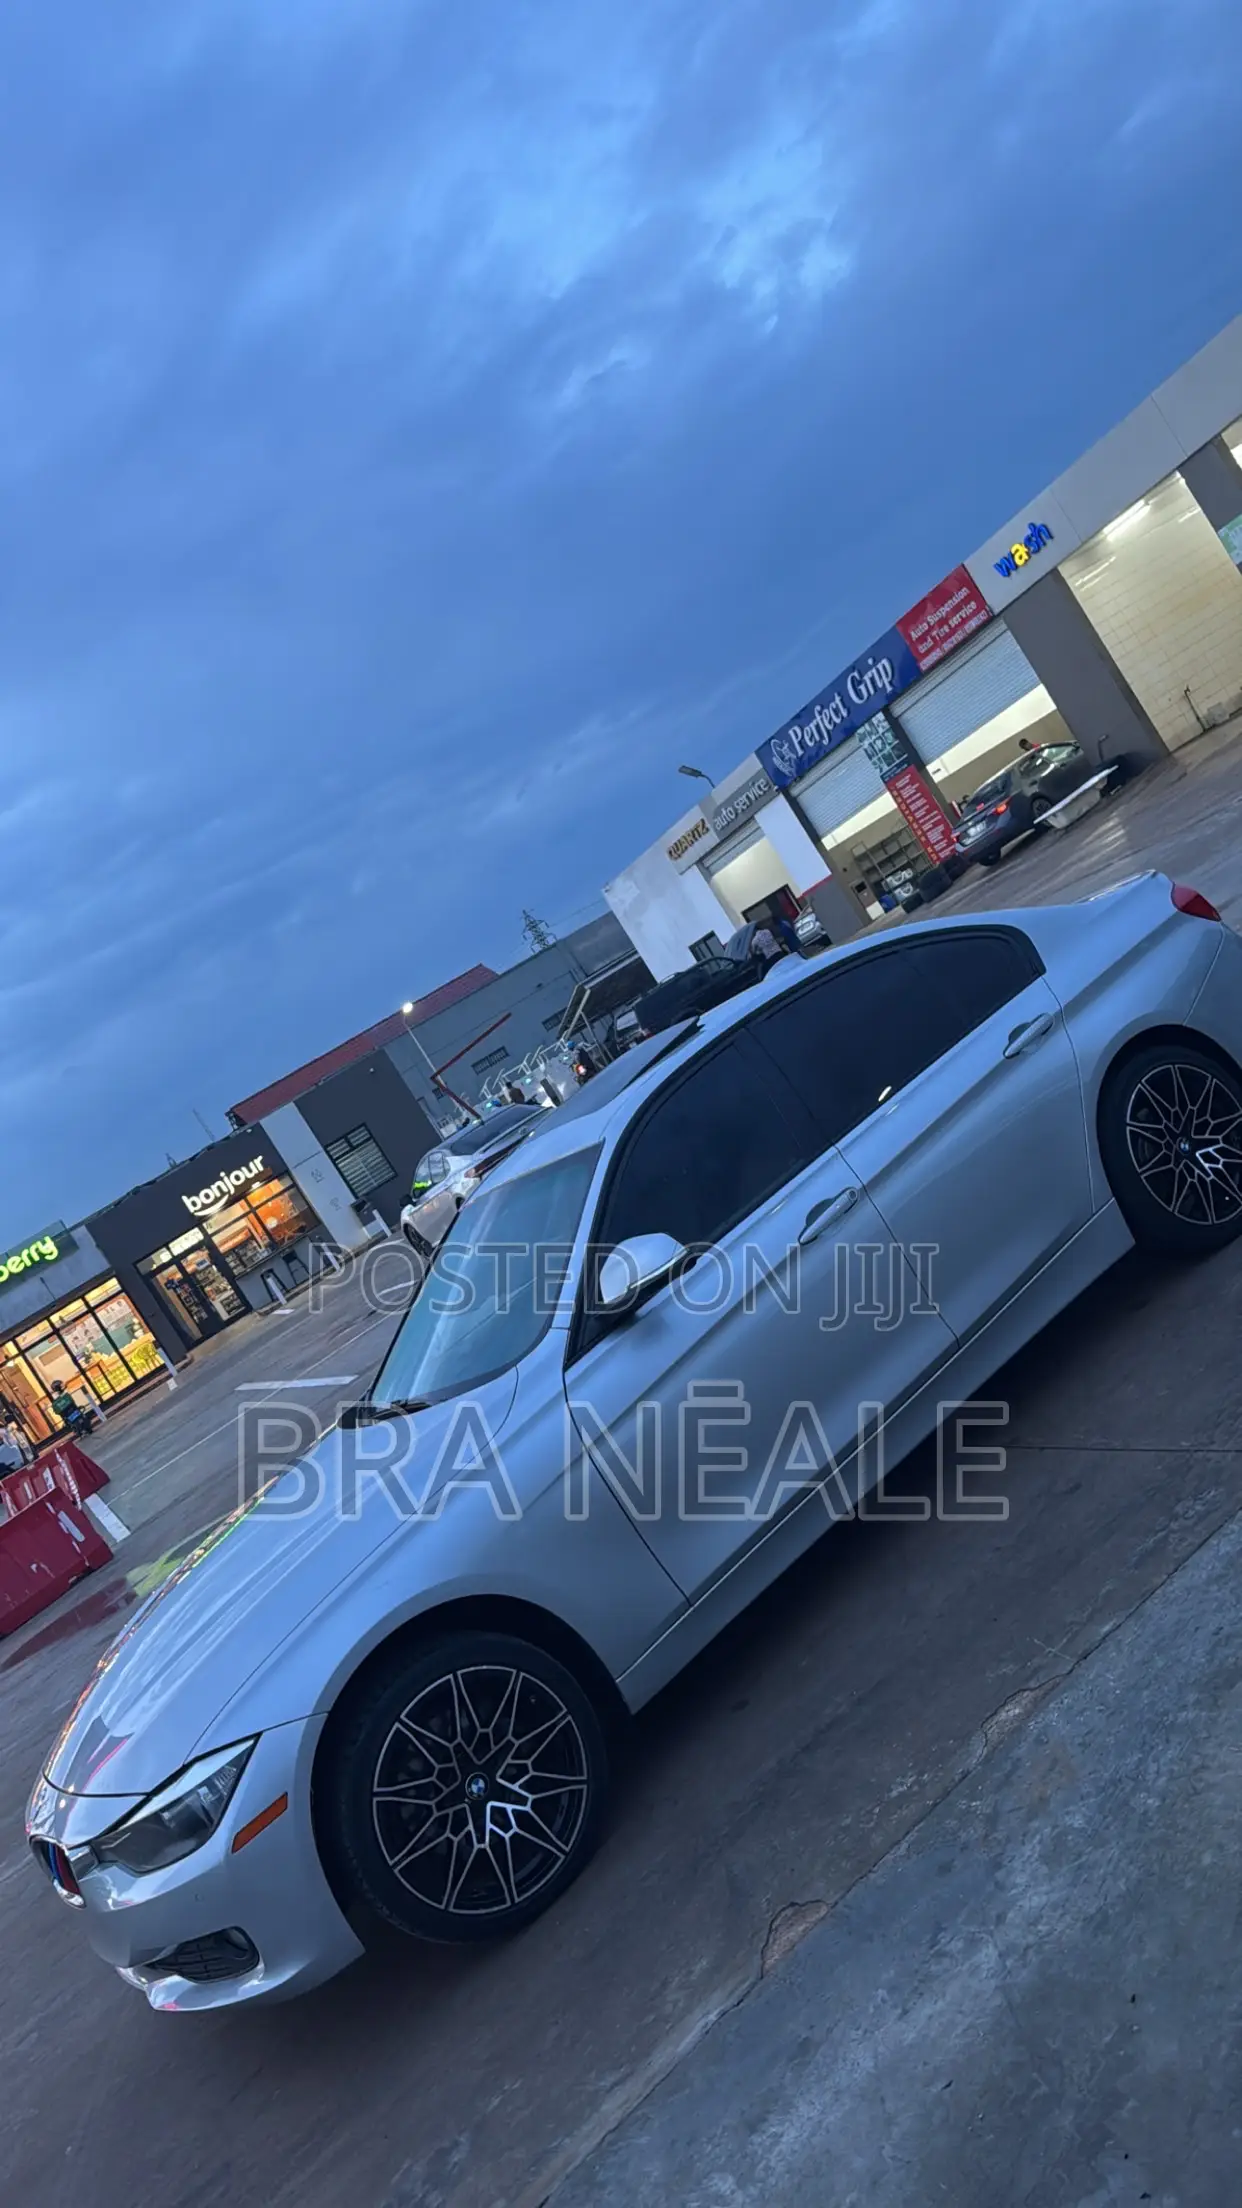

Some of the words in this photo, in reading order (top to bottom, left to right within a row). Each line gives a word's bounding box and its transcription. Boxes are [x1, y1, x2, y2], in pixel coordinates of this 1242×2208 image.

[994, 522, 1054, 577] wash
[910, 622, 929, 641] Auto
[927, 586, 970, 626] Suspension
[918, 635, 934, 654] and
[931, 624, 950, 640] Tire
[948, 600, 977, 628] service
[788, 692, 848, 758] Perfect
[846, 657, 893, 704] Grip
[714, 805, 736, 831] auto
[734, 778, 769, 813] service
[667, 818, 709, 861] QUARTZ
[181, 1155, 264, 1214] bonjour
